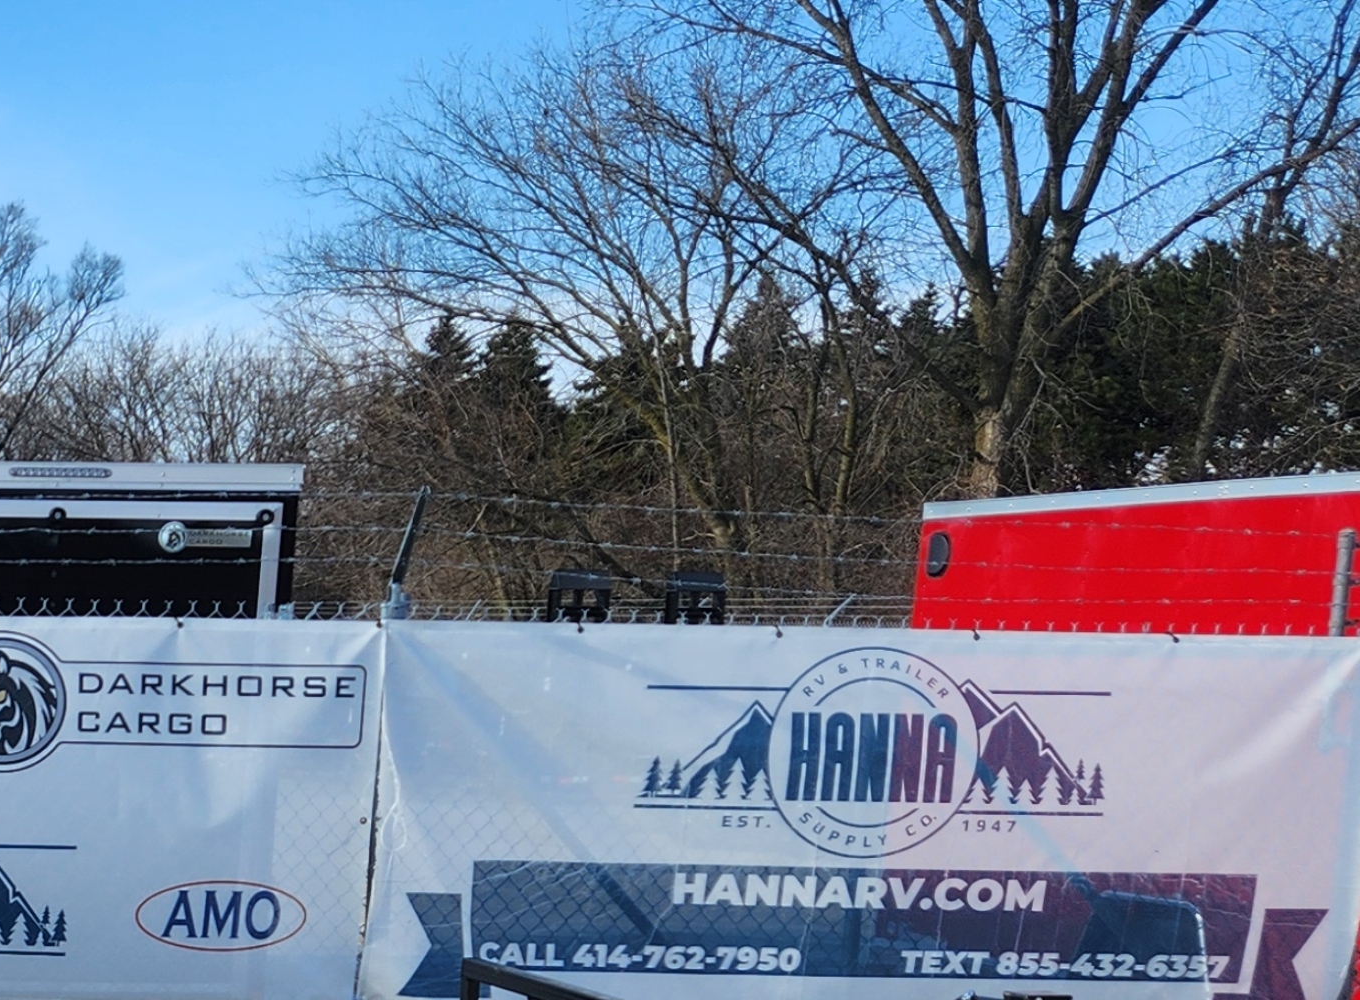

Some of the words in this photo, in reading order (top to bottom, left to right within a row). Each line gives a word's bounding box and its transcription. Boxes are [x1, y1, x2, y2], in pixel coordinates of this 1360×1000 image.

[78, 671, 358, 699] DARKHORSE
[802, 674, 826, 698] RV
[837, 662, 849, 675] &
[861, 656, 950, 699] TRAILER
[78, 710, 228, 736] CARGO
[785, 711, 958, 804] HANNA
[721, 815, 771, 829] EST.
[798, 810, 888, 848] SUPPLY
[904, 813, 938, 837] CO.
[962, 819, 1017, 833] 1947
[673, 872, 1047, 913] HANNARV.COM
[161, 889, 281, 941] AMO
[480, 942, 565, 967] CALL
[572, 943, 803, 972] 414-762-7950
[900, 950, 991, 975] TEXT
[996, 951, 1230, 979] 855-432-6357
